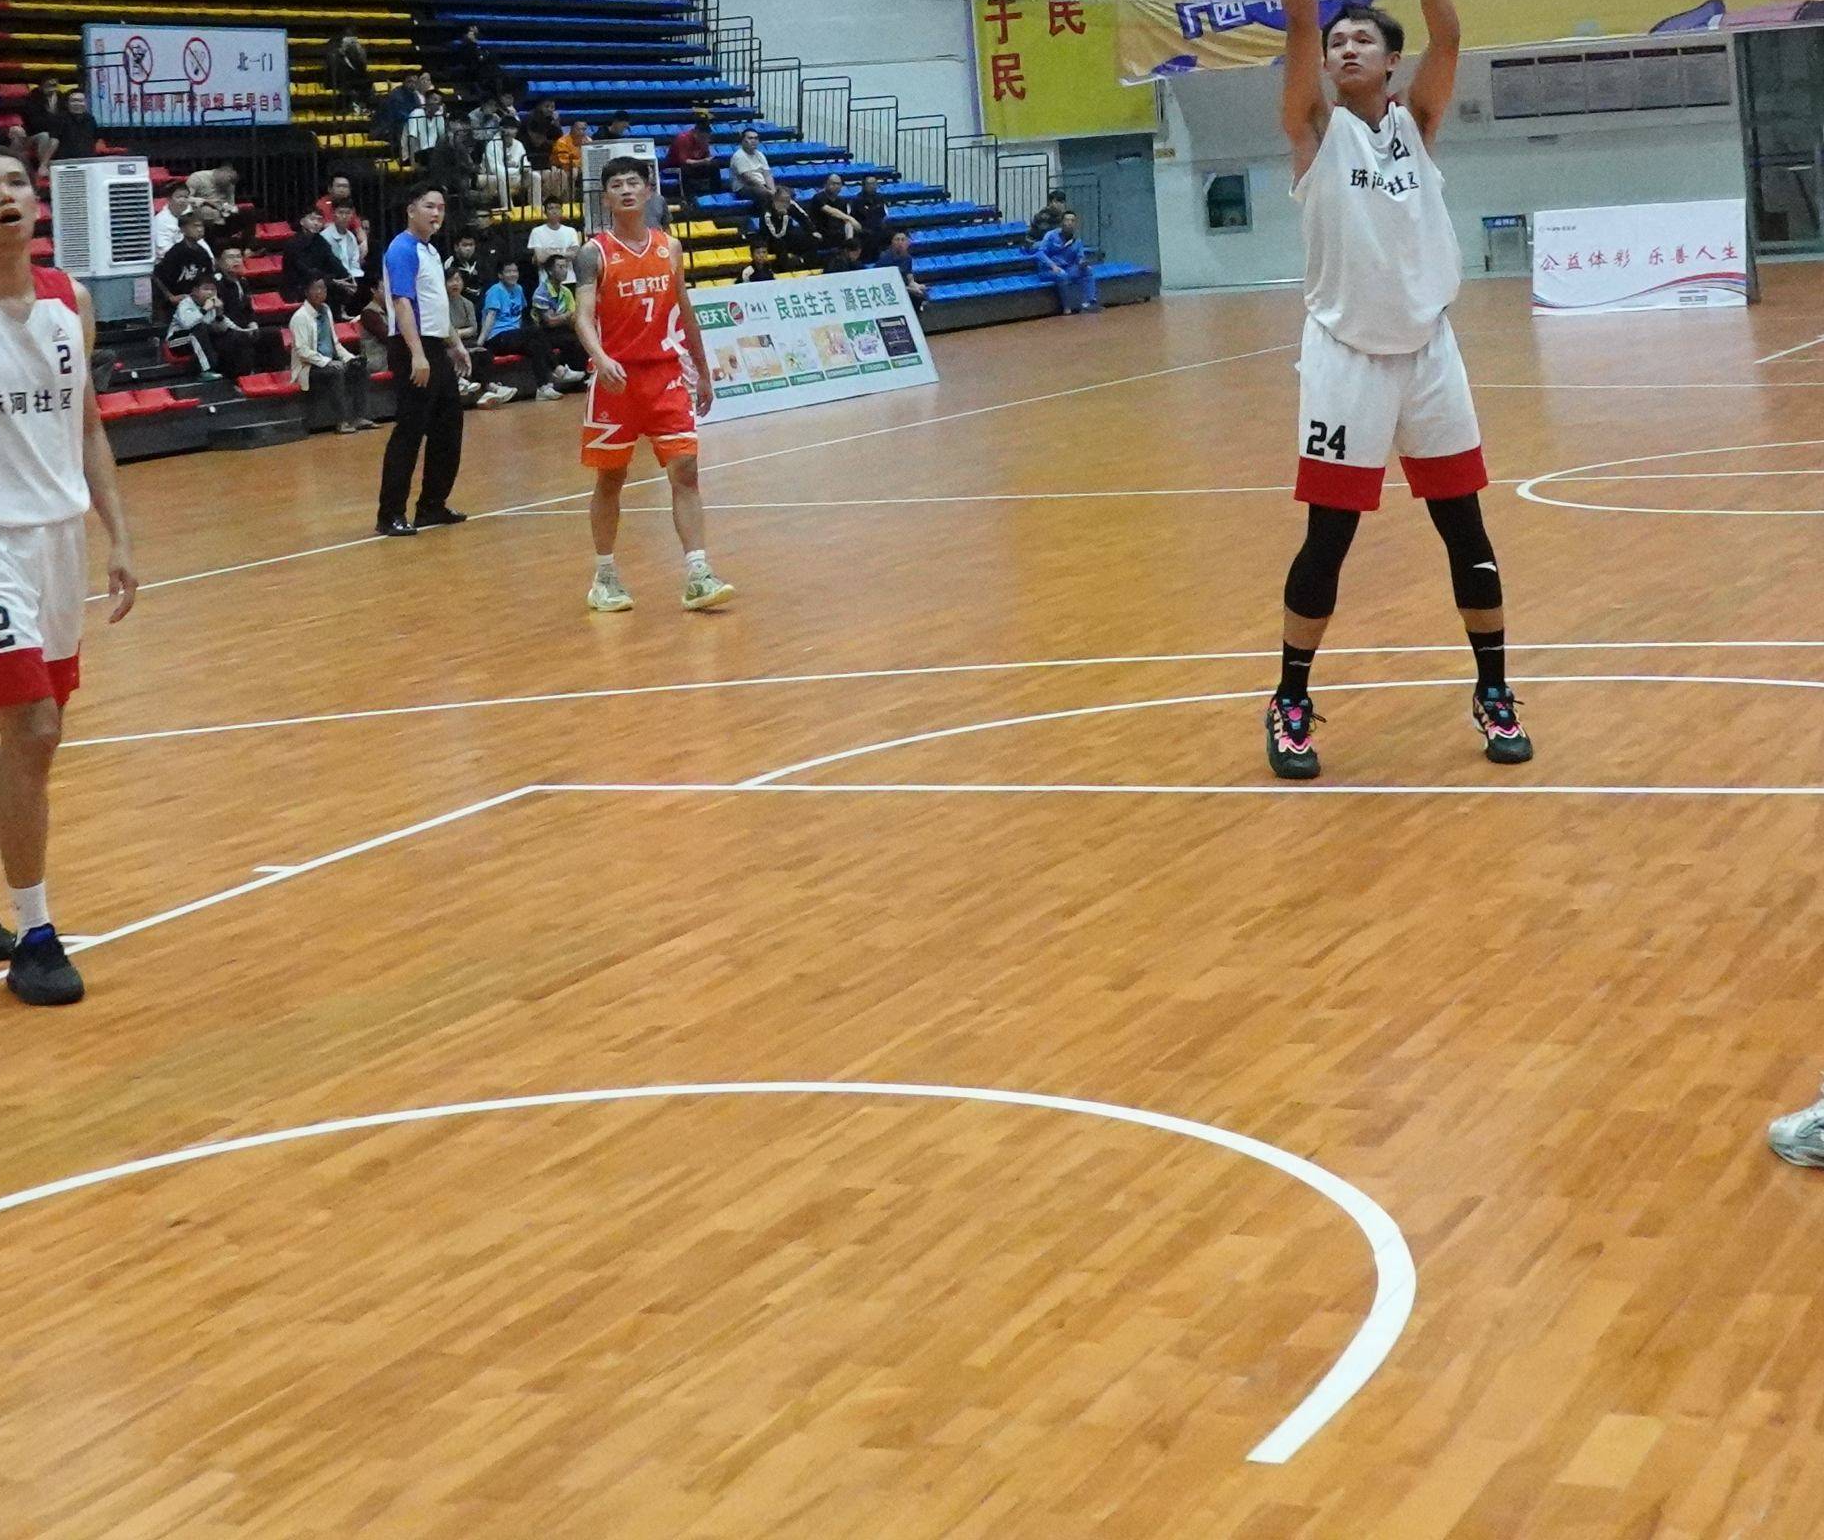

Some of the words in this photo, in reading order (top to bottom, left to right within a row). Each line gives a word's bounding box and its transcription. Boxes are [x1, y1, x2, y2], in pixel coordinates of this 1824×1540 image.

[1539, 246, 1632, 271] 公益体彩
[1648, 240, 1739, 268] 乐善人生
[641, 298, 656, 323] 7
[774, 290, 837, 321] 良品生活
[840, 283, 900, 312] 源自农垦
[57, 344, 72, 375] 2
[1305, 419, 1347, 461] 24
